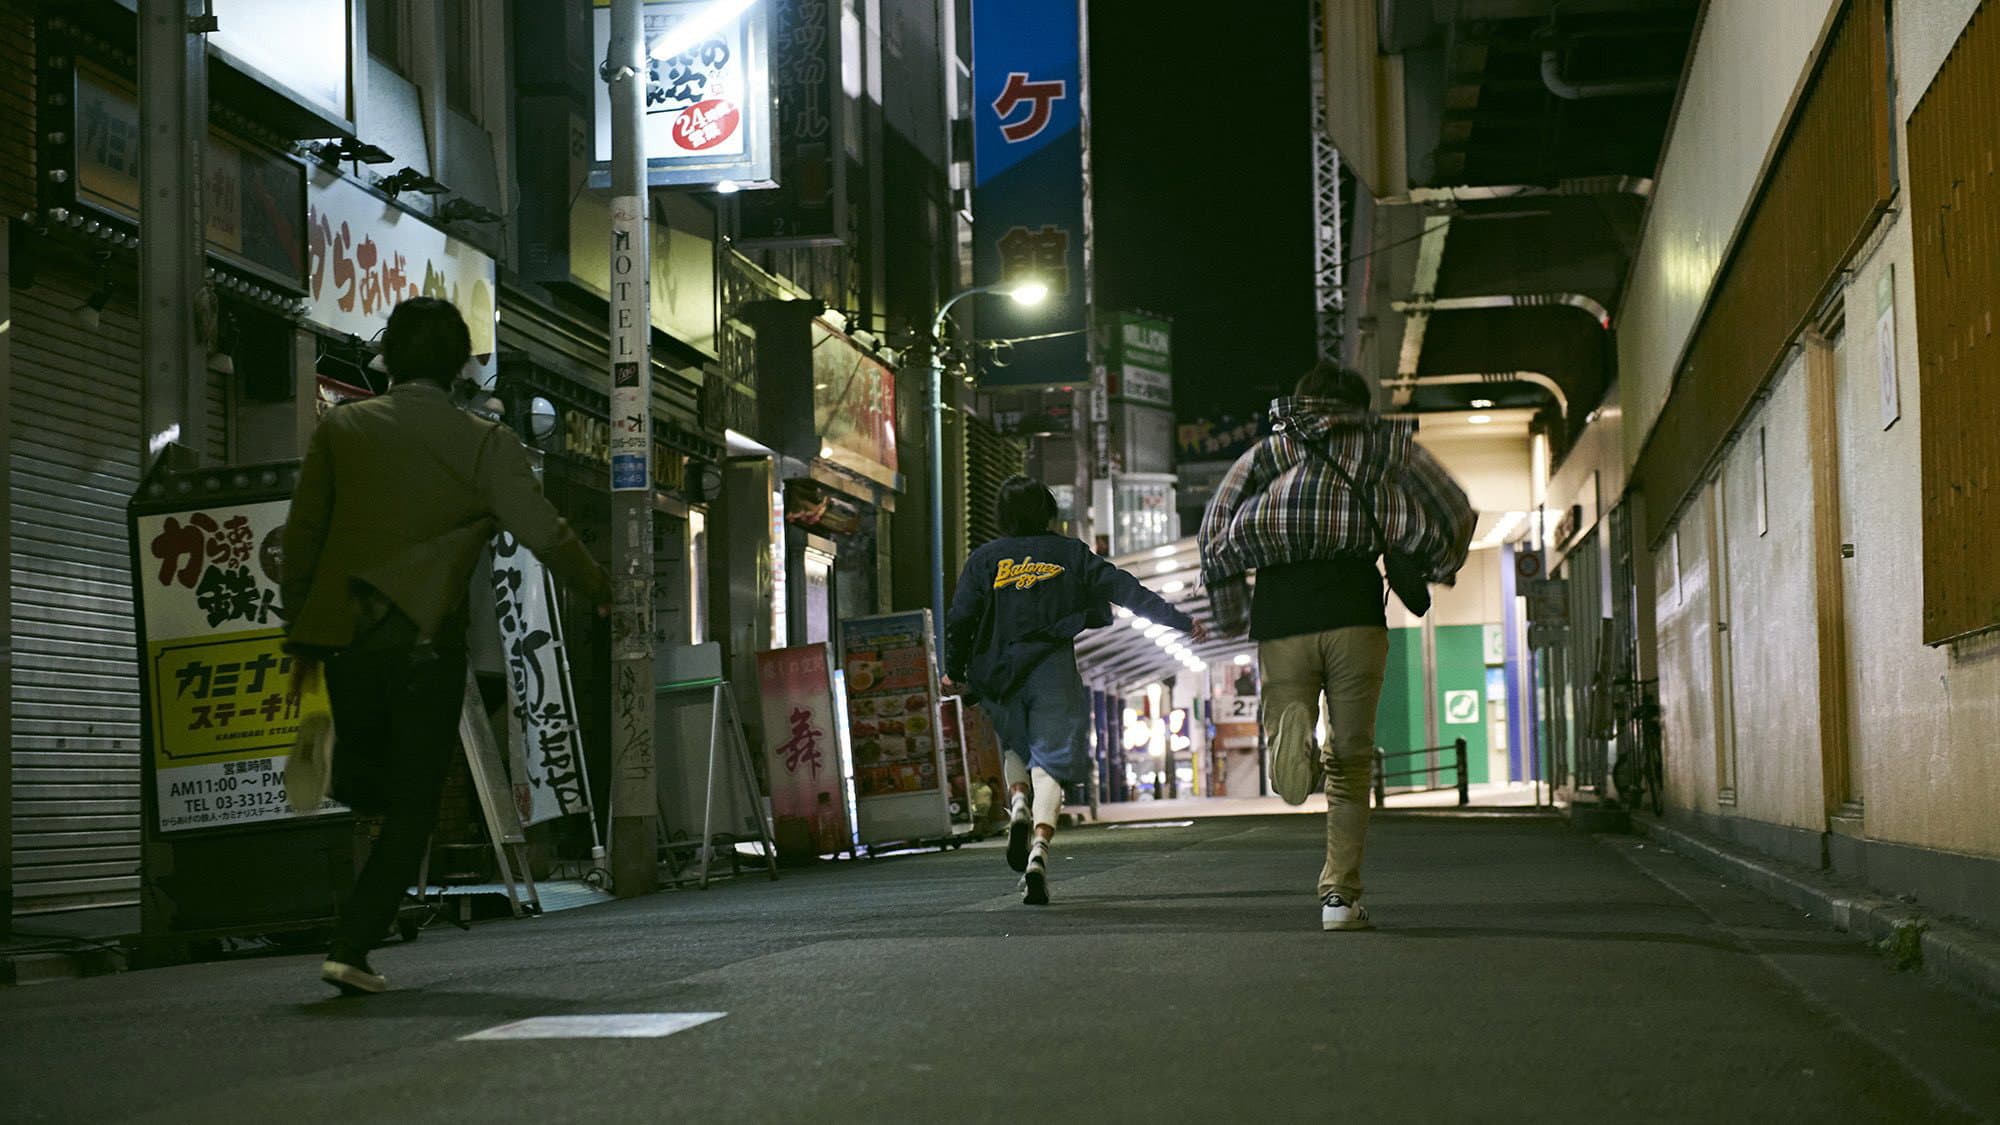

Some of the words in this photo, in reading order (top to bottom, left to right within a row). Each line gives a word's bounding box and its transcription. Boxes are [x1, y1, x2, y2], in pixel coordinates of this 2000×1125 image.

[614, 230, 633, 356] HOTEL
[775, 707, 823, 782] 舞
[223, 758, 273, 776] 営業時間
[170, 776, 237, 797] AM11:00
[184, 800, 210, 813] TEL
